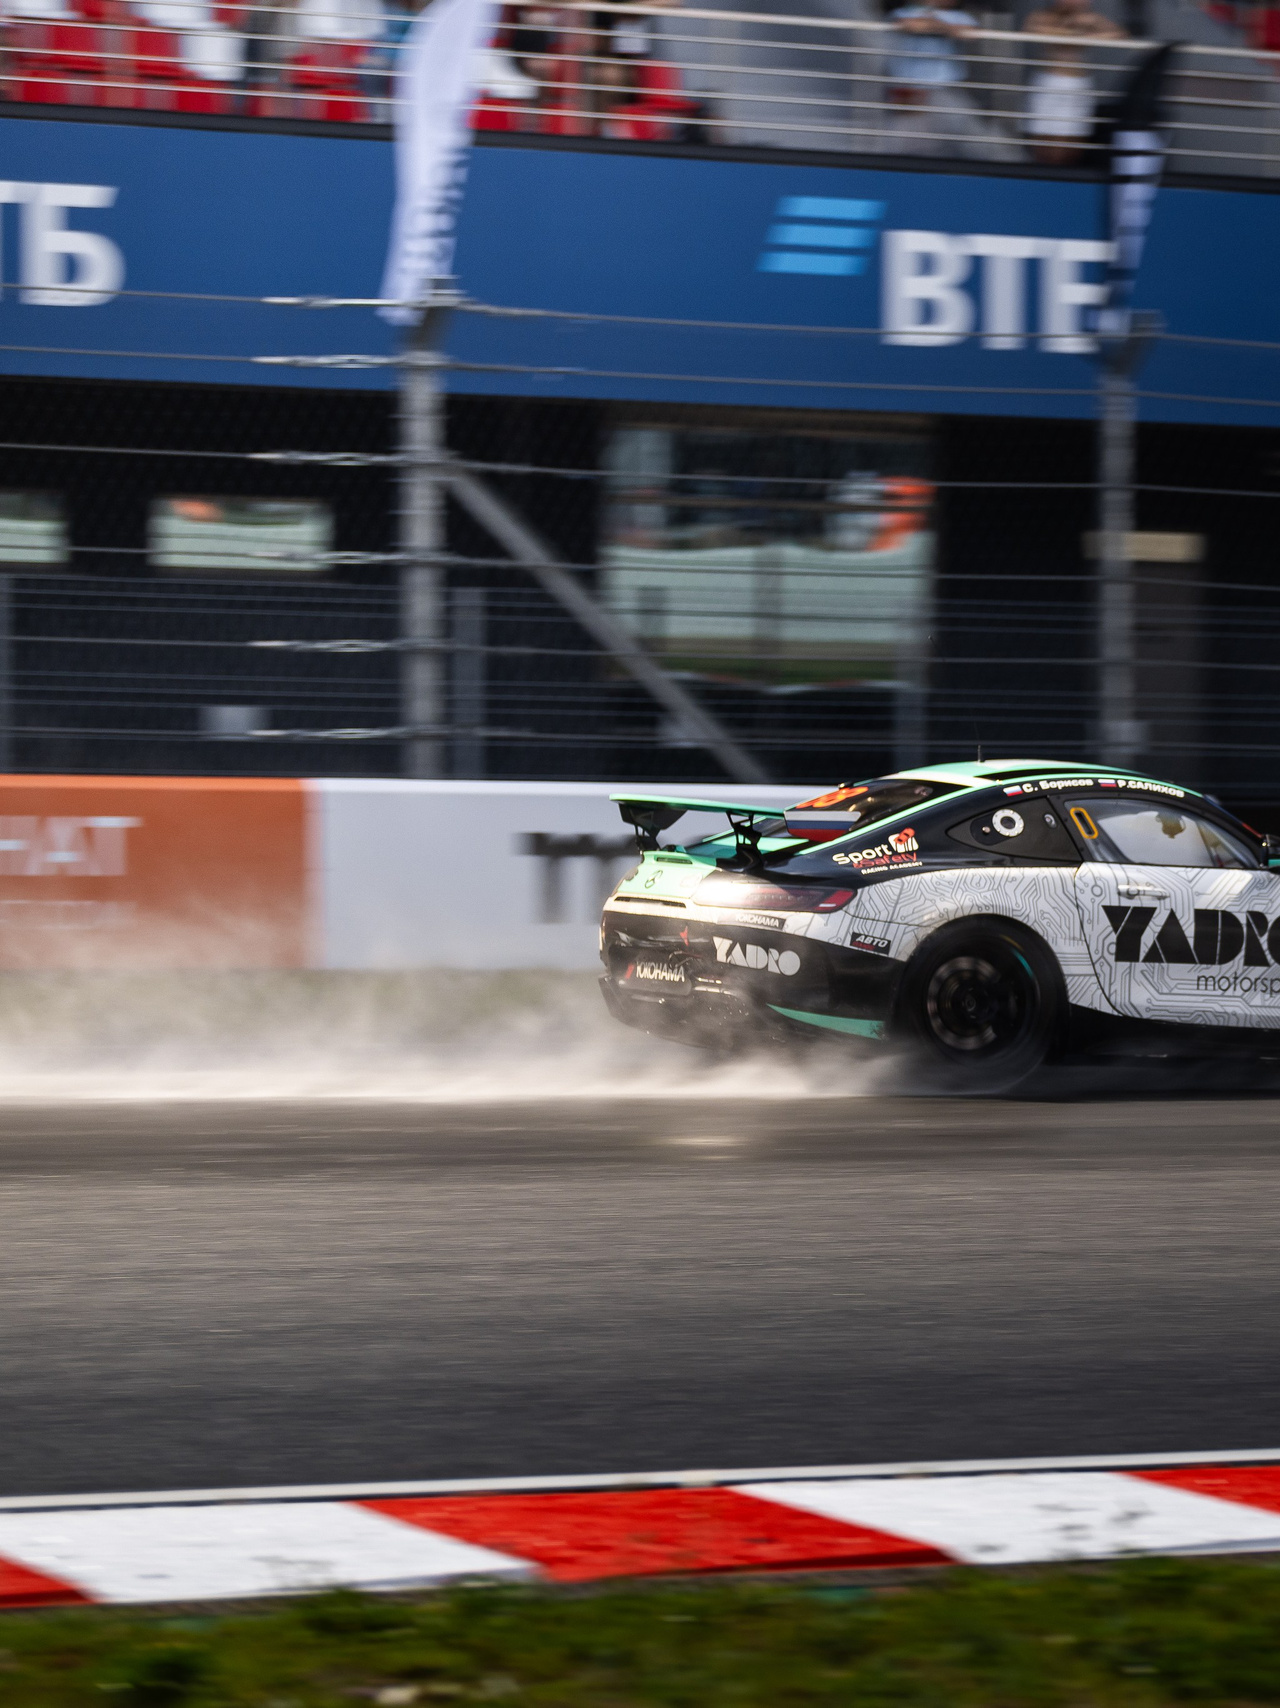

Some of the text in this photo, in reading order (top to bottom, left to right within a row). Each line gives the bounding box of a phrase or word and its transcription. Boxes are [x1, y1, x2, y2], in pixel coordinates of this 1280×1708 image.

[832, 844, 893, 865] Sport
[861, 865, 888, 875] RACING
[735, 913, 780, 928] YOKOHAMA
[855, 935, 889, 948] АВТО
[713, 936, 801, 976] YADRO
[636, 961, 686, 982] YOKOHAMA
